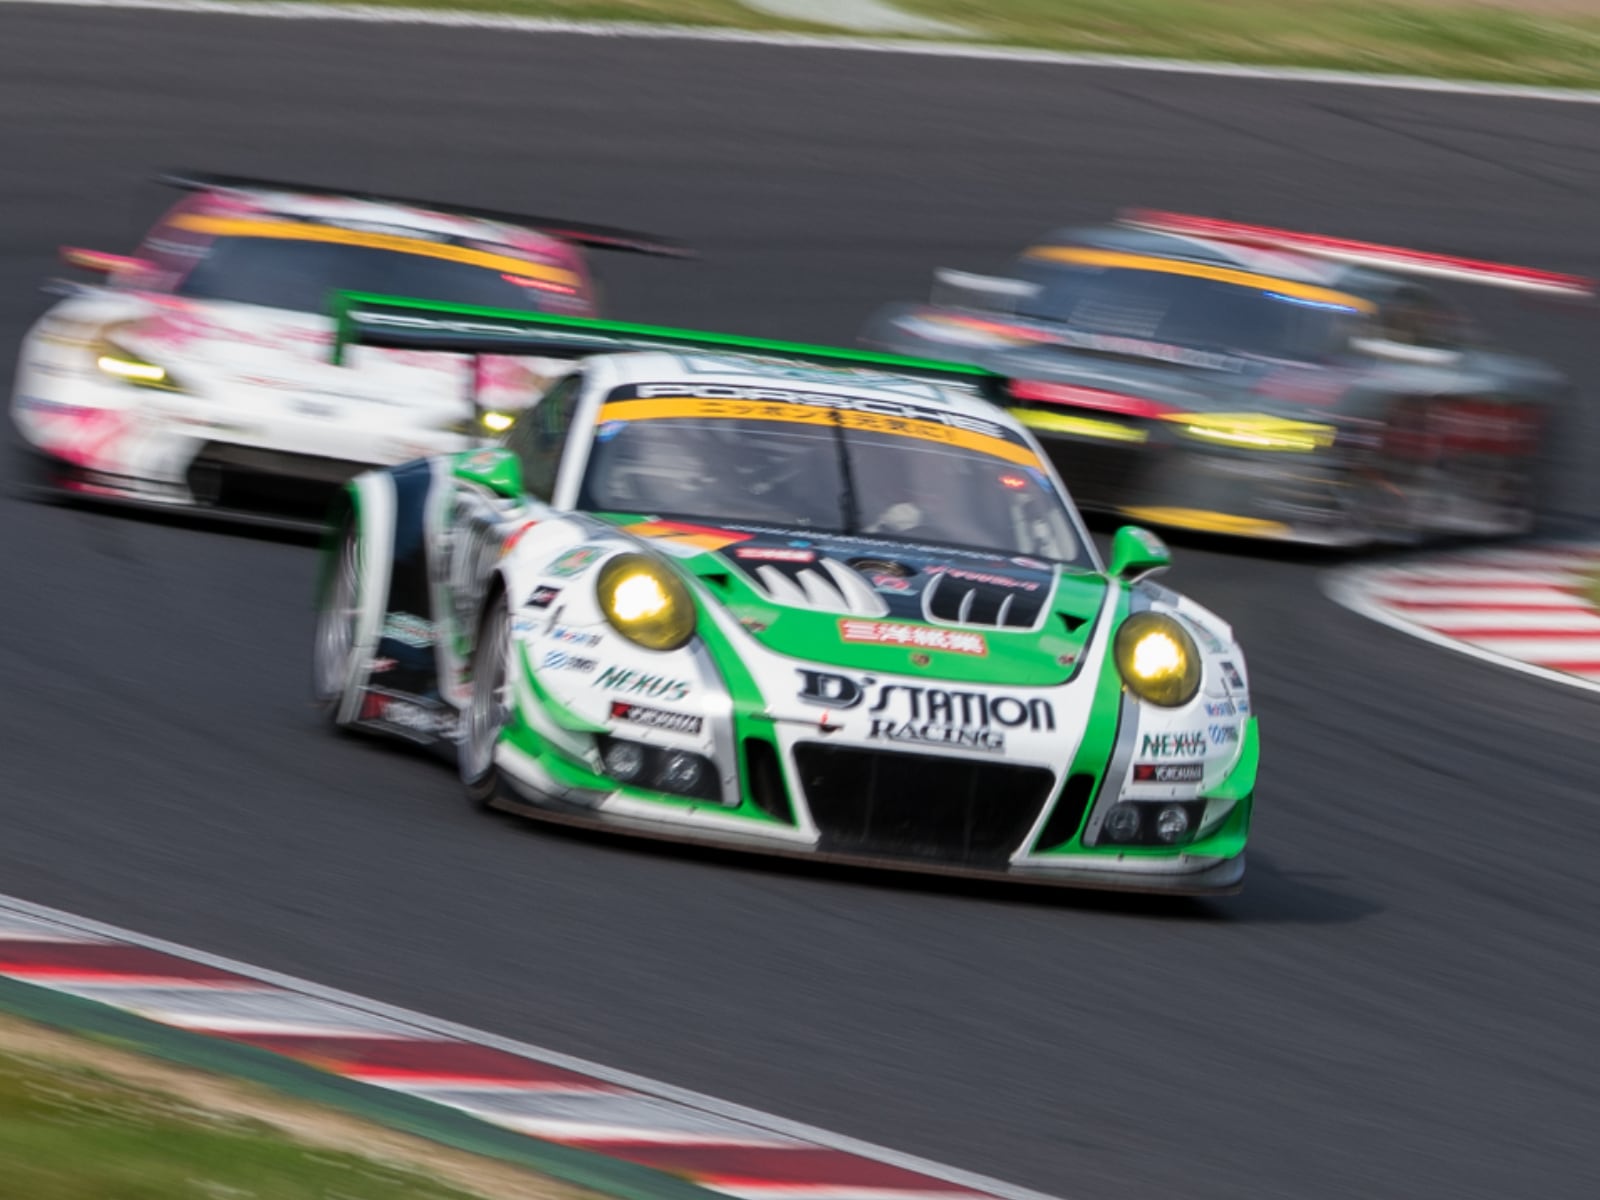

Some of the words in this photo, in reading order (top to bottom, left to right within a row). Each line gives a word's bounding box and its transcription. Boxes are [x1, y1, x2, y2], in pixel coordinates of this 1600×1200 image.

[636, 384, 1005, 439] PORSCHE
[593, 665, 690, 700] NEXUS
[868, 718, 1005, 751] RACING
[1141, 731, 1207, 757] NEXUS
